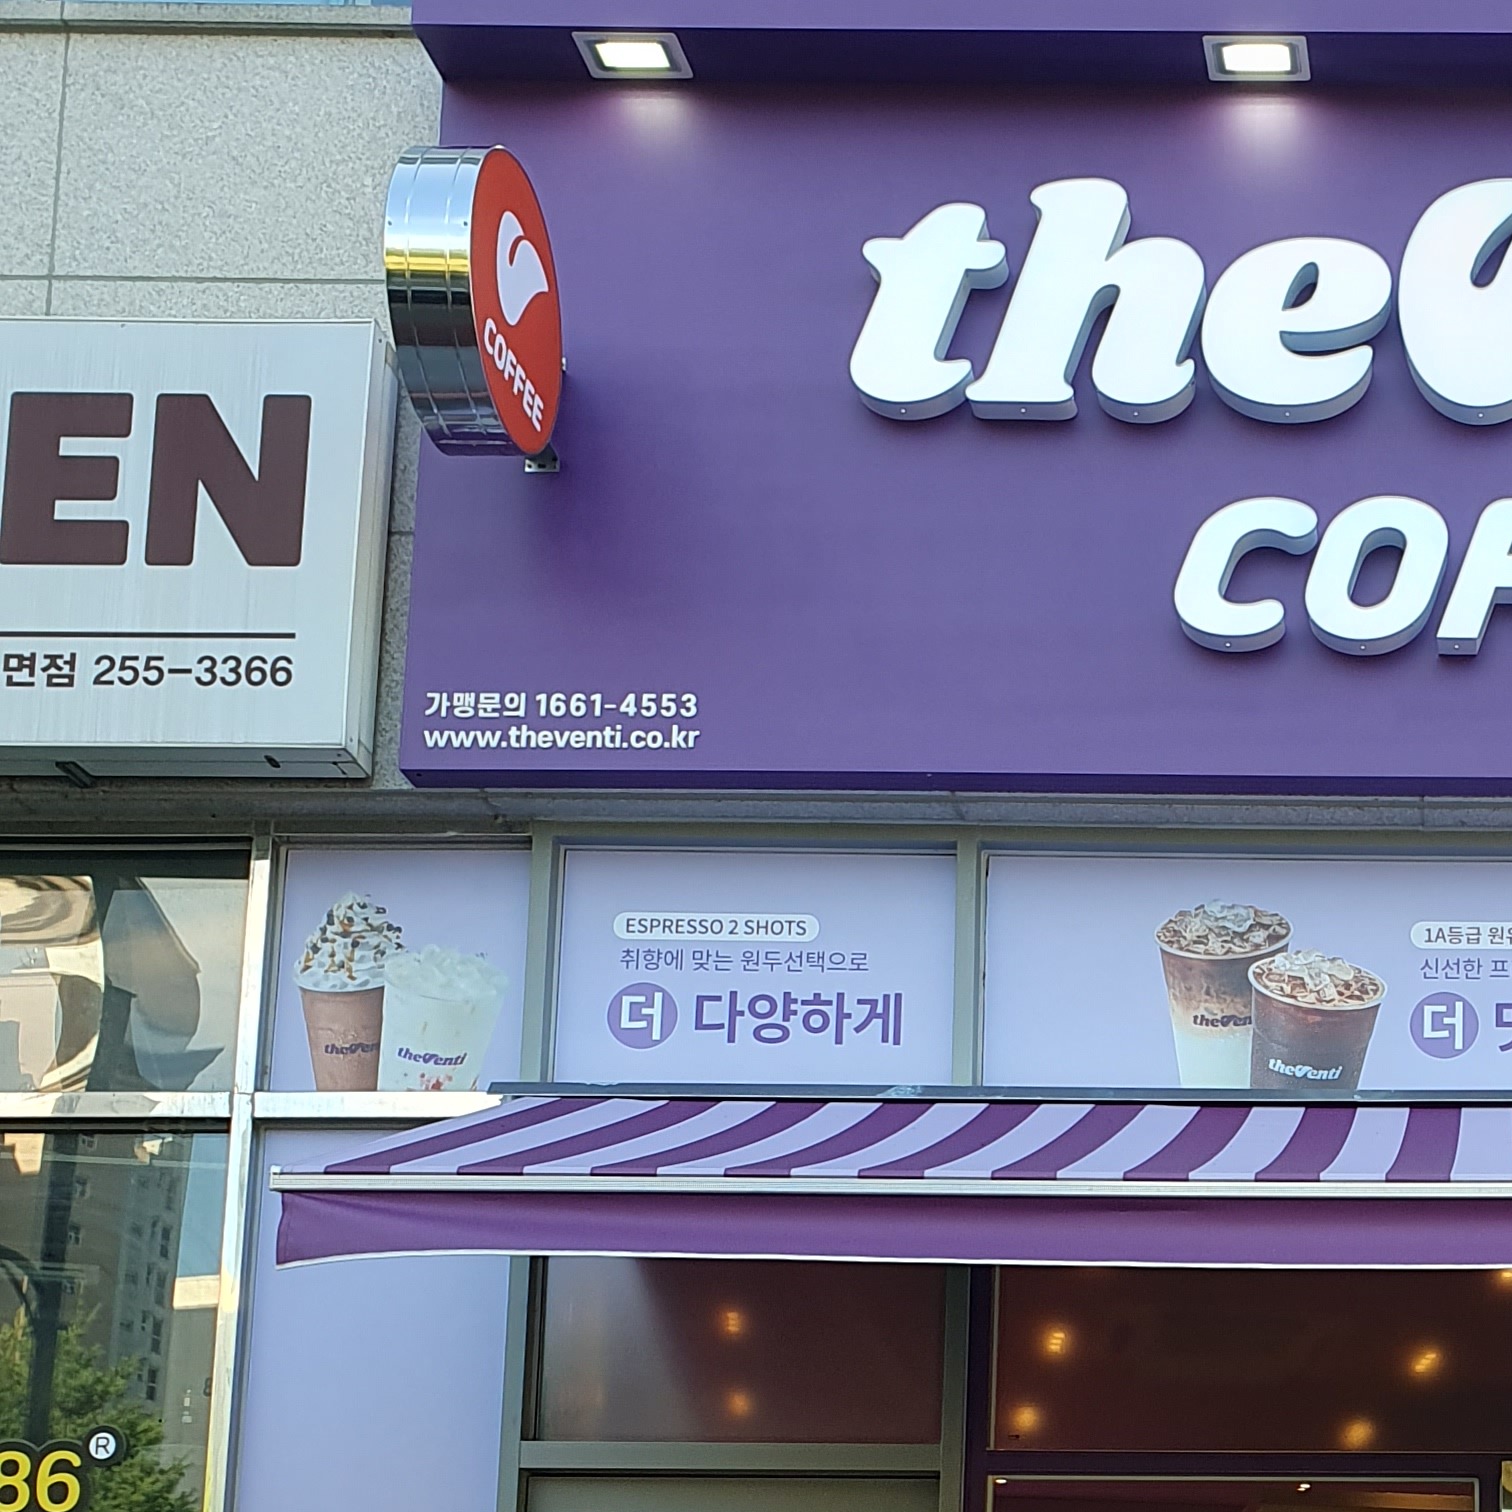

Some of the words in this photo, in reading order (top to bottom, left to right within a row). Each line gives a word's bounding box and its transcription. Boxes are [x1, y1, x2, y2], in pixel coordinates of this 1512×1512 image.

[483, 316, 545, 433] COFFEE
[0, 392, 311, 567] EN
[3, 651, 77, 688] 면점
[93, 655, 294, 688] 255-3366
[424, 691, 527, 720] 가맹문의
[536, 694, 698, 719] 1661-4553
[423, 725, 701, 751] www.theventi.co.kr
[624, 917, 724, 936] ESPRESSO
[727, 918, 739, 935] 2
[742, 917, 808, 937] SHOTS
[1424, 926, 1482, 945] 1A등급
[619, 947, 684, 972] 취향에
[691, 947, 734, 972] 맞는
[740, 948, 869, 974] 원두선택으로
[1419, 959, 1484, 981] 신선한
[618, 991, 664, 1042] 더
[694, 991, 903, 1046] 다양하게
[1422, 1001, 1466, 1051] 더
